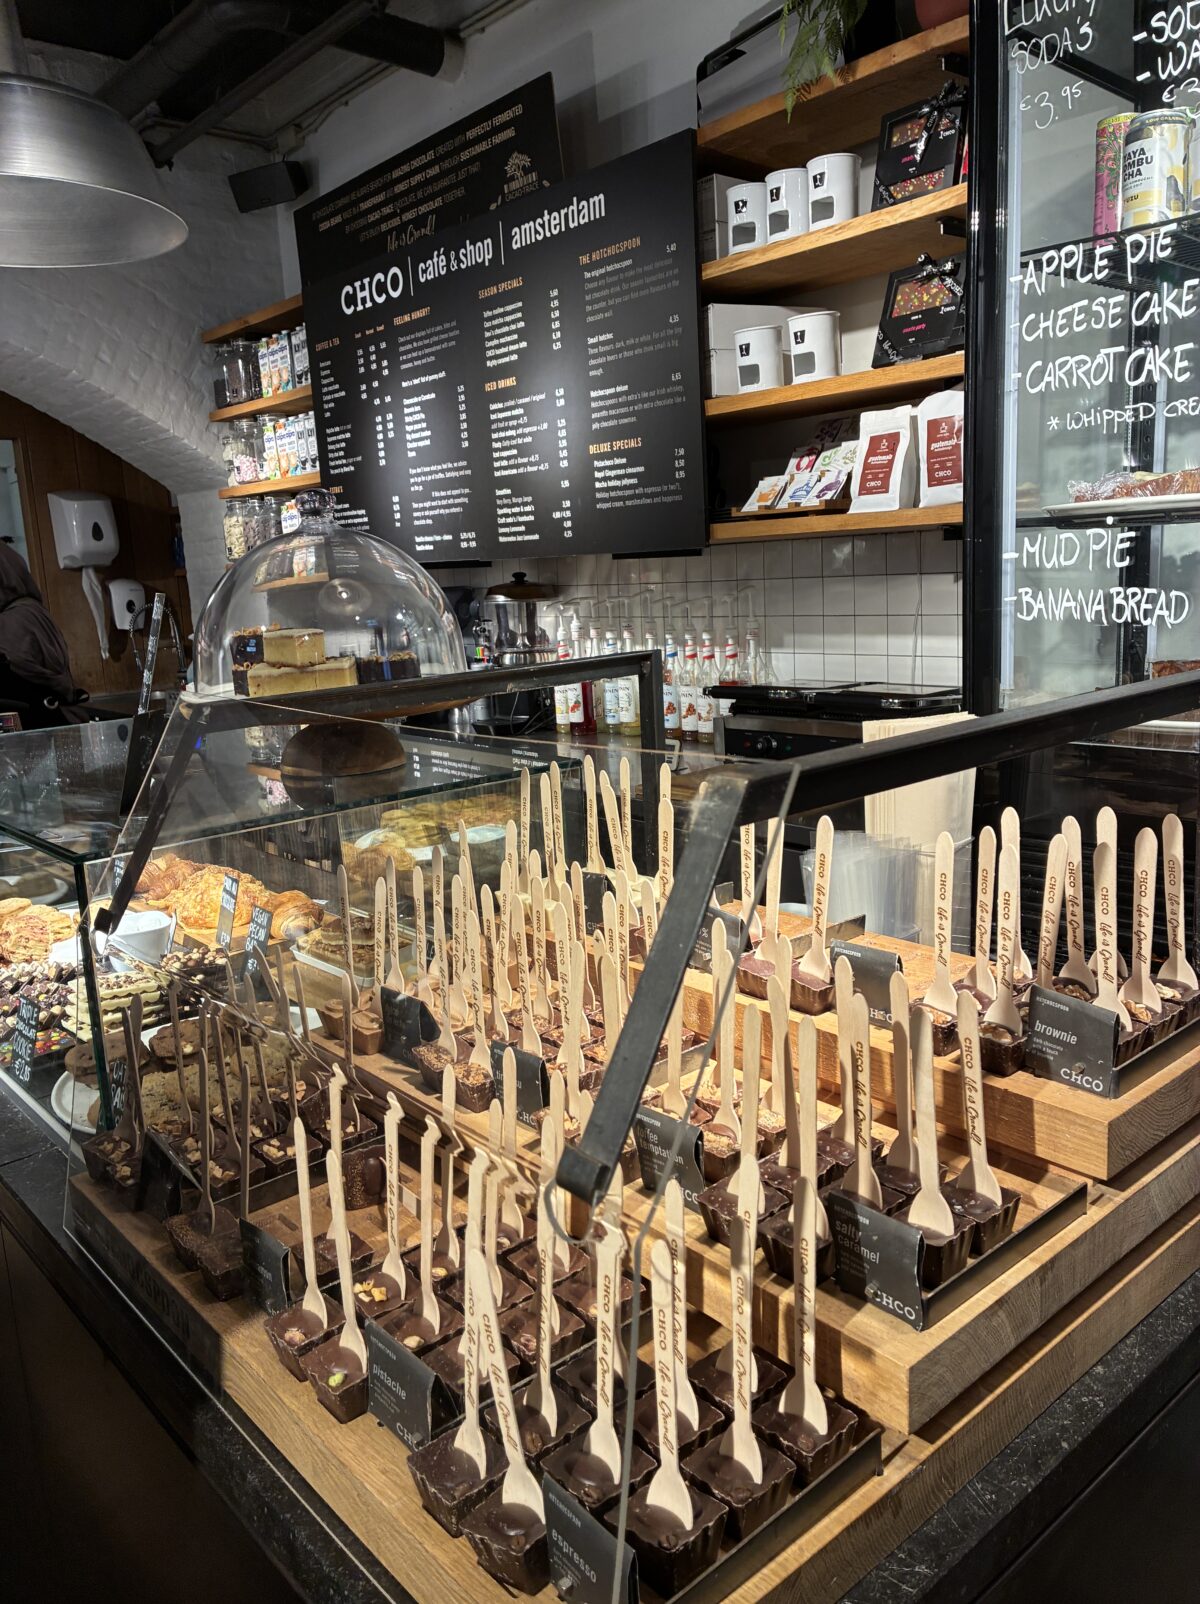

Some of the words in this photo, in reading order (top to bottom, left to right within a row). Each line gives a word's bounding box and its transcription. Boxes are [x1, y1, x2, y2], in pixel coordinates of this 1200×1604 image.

[1012, 16, 1093, 74] SODA'S
[465, 120, 492, 141] PERFECTLY
[492, 104, 523, 127] FERMENTED
[460, 138, 492, 161] SUSTAINABLE
[341, 266, 404, 315] CHCO
[418, 247, 447, 283] café
[450, 253, 458, 272] &
[459, 237, 493, 267] shop
[511, 192, 606, 250] amsterdam
[579, 254, 590, 266] THE
[591, 237, 641, 261] HOTCHOCSPOON
[1126, 223, 1178, 283] PIE
[479, 285, 498, 299] SEASON
[498, 276, 523, 292] SPECIALS
[1132, 280, 1200, 326] CAKE
[393, 313, 411, 326] FEELING
[1125, 343, 1194, 387] CAKE
[589, 441, 611, 455] DELUXE
[612, 437, 642, 451] SPECIALS
[1086, 528, 1136, 571] PIE
[1110, 586, 1189, 628] BREAD
[1140, 869, 1148, 898] CHCO
[1003, 891, 1011, 920] CHCO
[1101, 887, 1109, 916] CHCO
[1034, 1020, 1078, 1045] brownie
[964, 1037, 974, 1070] CHCO
[1060, 1067, 1104, 1092] CHCO
[835, 1221, 862, 1242] salty
[838, 1236, 880, 1264] caramel
[603, 1274, 611, 1314] CHCO
[482, 1314, 496, 1354] CHCO
[659, 1308, 667, 1350] CHCO
[373, 1363, 407, 1400] pistache
[552, 1529, 597, 1583] espresso
